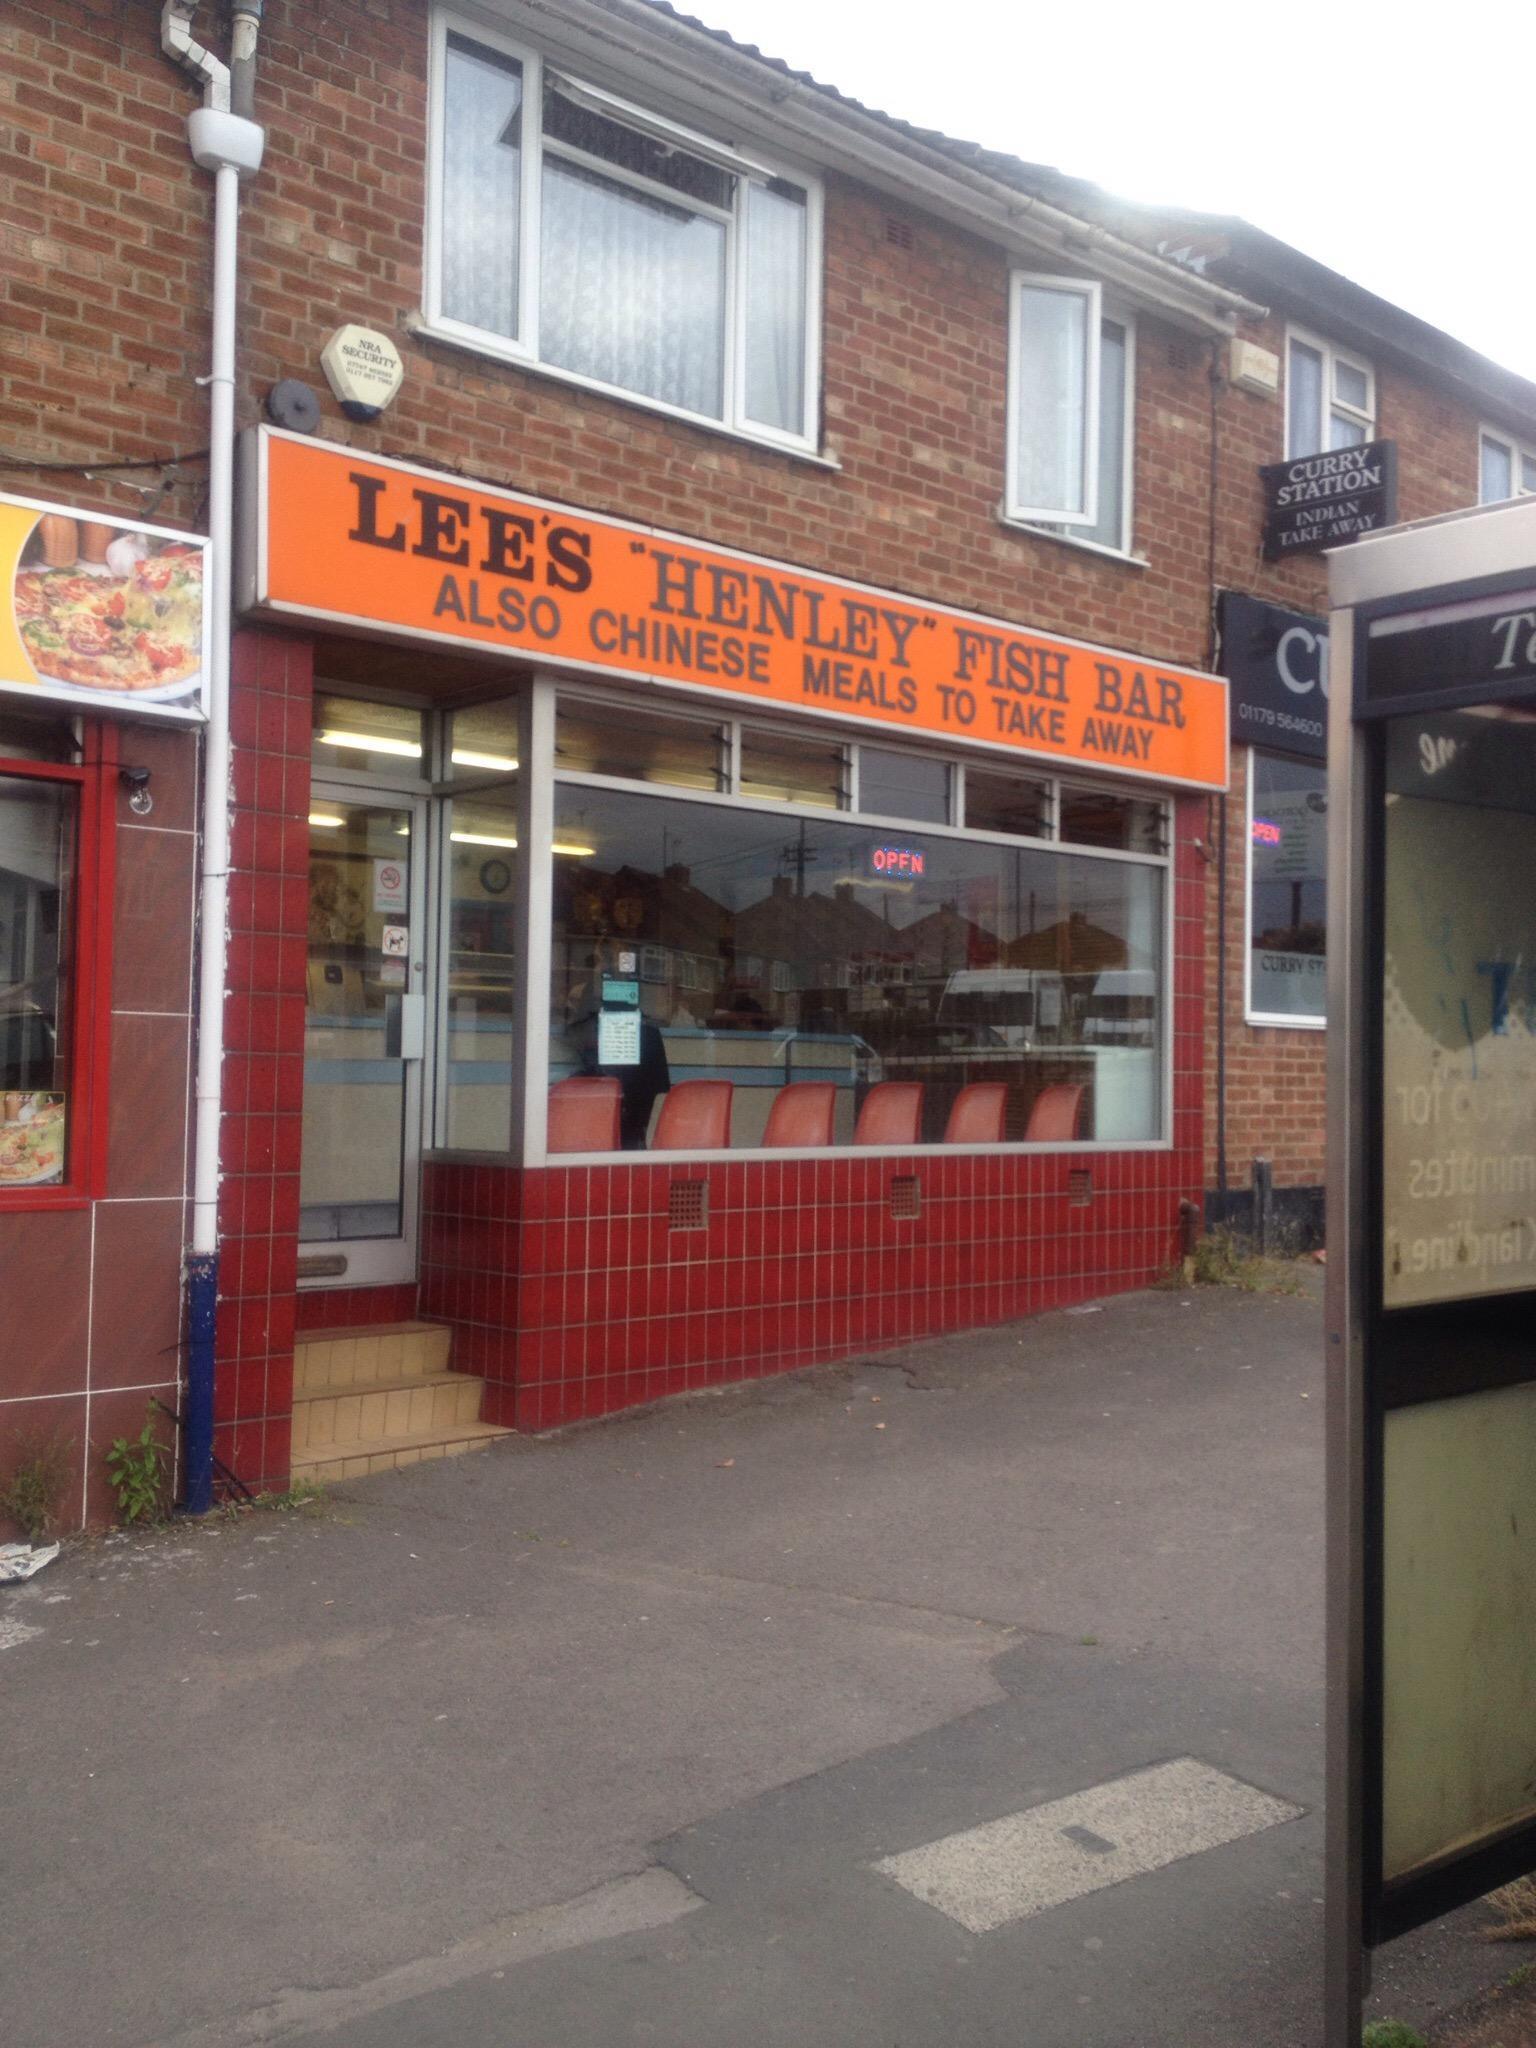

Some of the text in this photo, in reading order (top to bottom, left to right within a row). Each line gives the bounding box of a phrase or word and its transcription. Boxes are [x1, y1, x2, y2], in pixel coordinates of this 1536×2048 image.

[342, 344, 397, 369] SECURITY
[1288, 448, 1369, 483] CURRY
[1276, 465, 1382, 506] STATION
[1279, 513, 1376, 546] TAKE AWAY
[1296, 500, 1360, 527] INDIAN
[347, 471, 594, 594] LEE'S
[953, 627, 1071, 705] FISH
[1094, 662, 1187, 730] BAR
[432, 573, 1154, 760] ALSO CHINESE MEALS TO TAKE AWAY
[873, 848, 924, 874] OPEN
